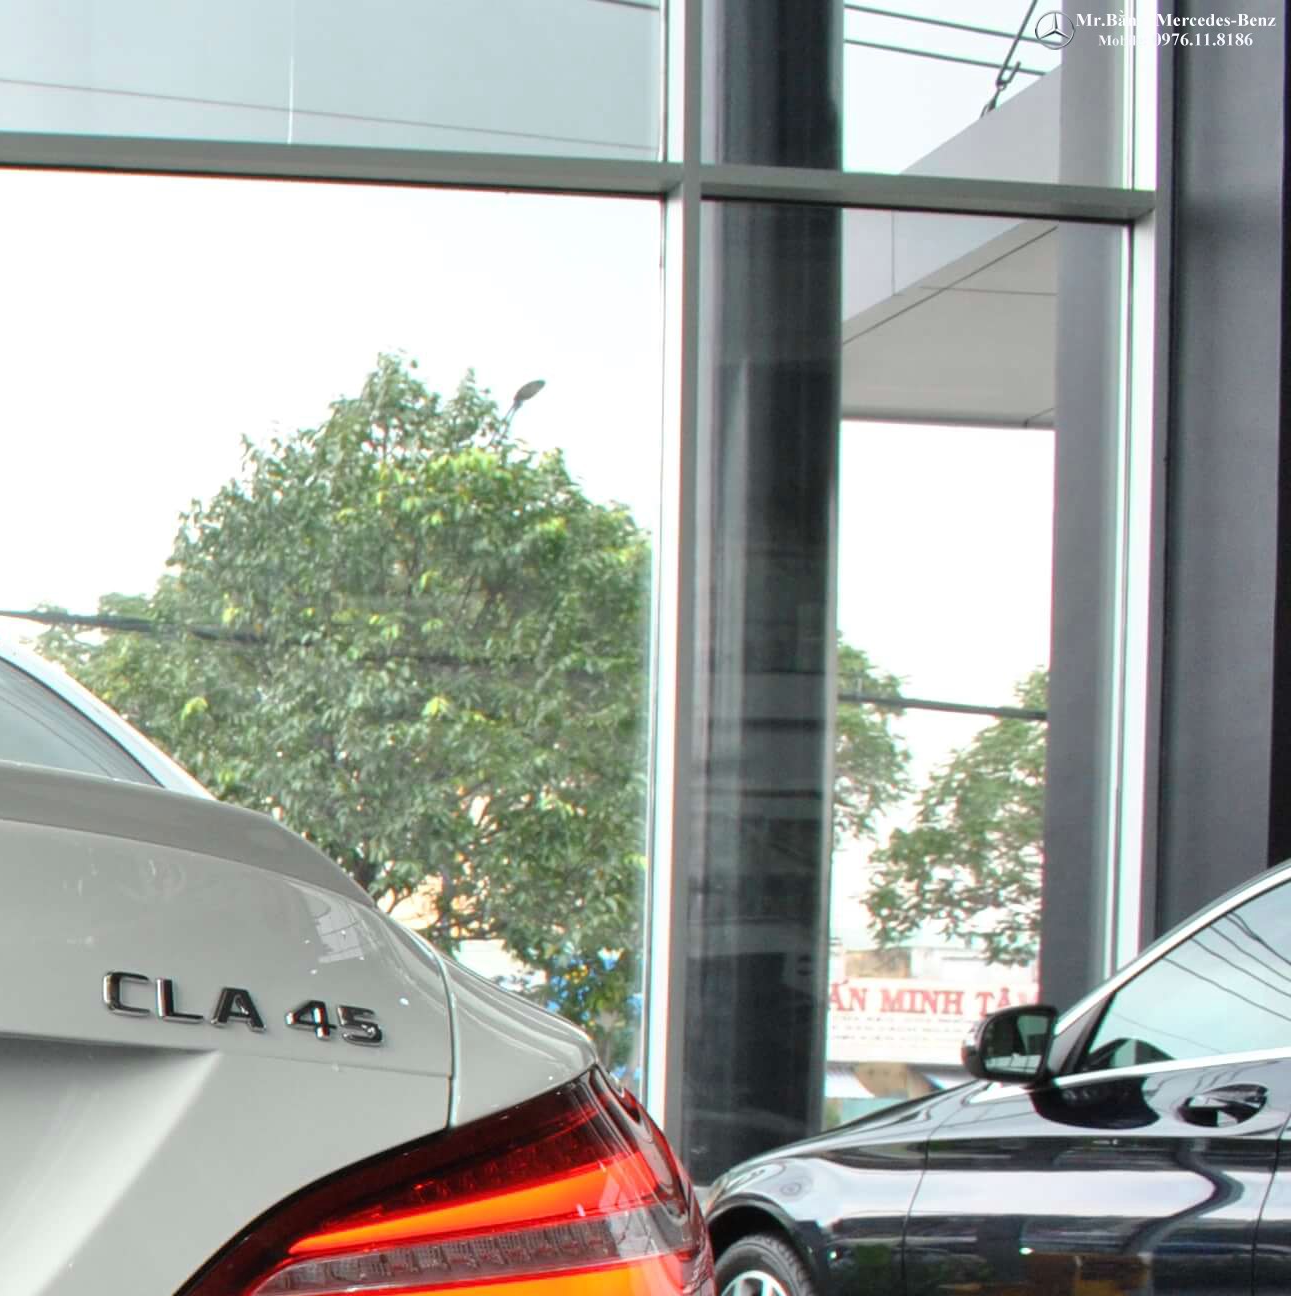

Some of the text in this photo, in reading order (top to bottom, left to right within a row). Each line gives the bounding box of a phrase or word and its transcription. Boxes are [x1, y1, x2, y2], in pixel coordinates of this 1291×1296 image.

[102, 970, 384, 1048] CLA 45
[880, 988, 964, 1015] MINH
